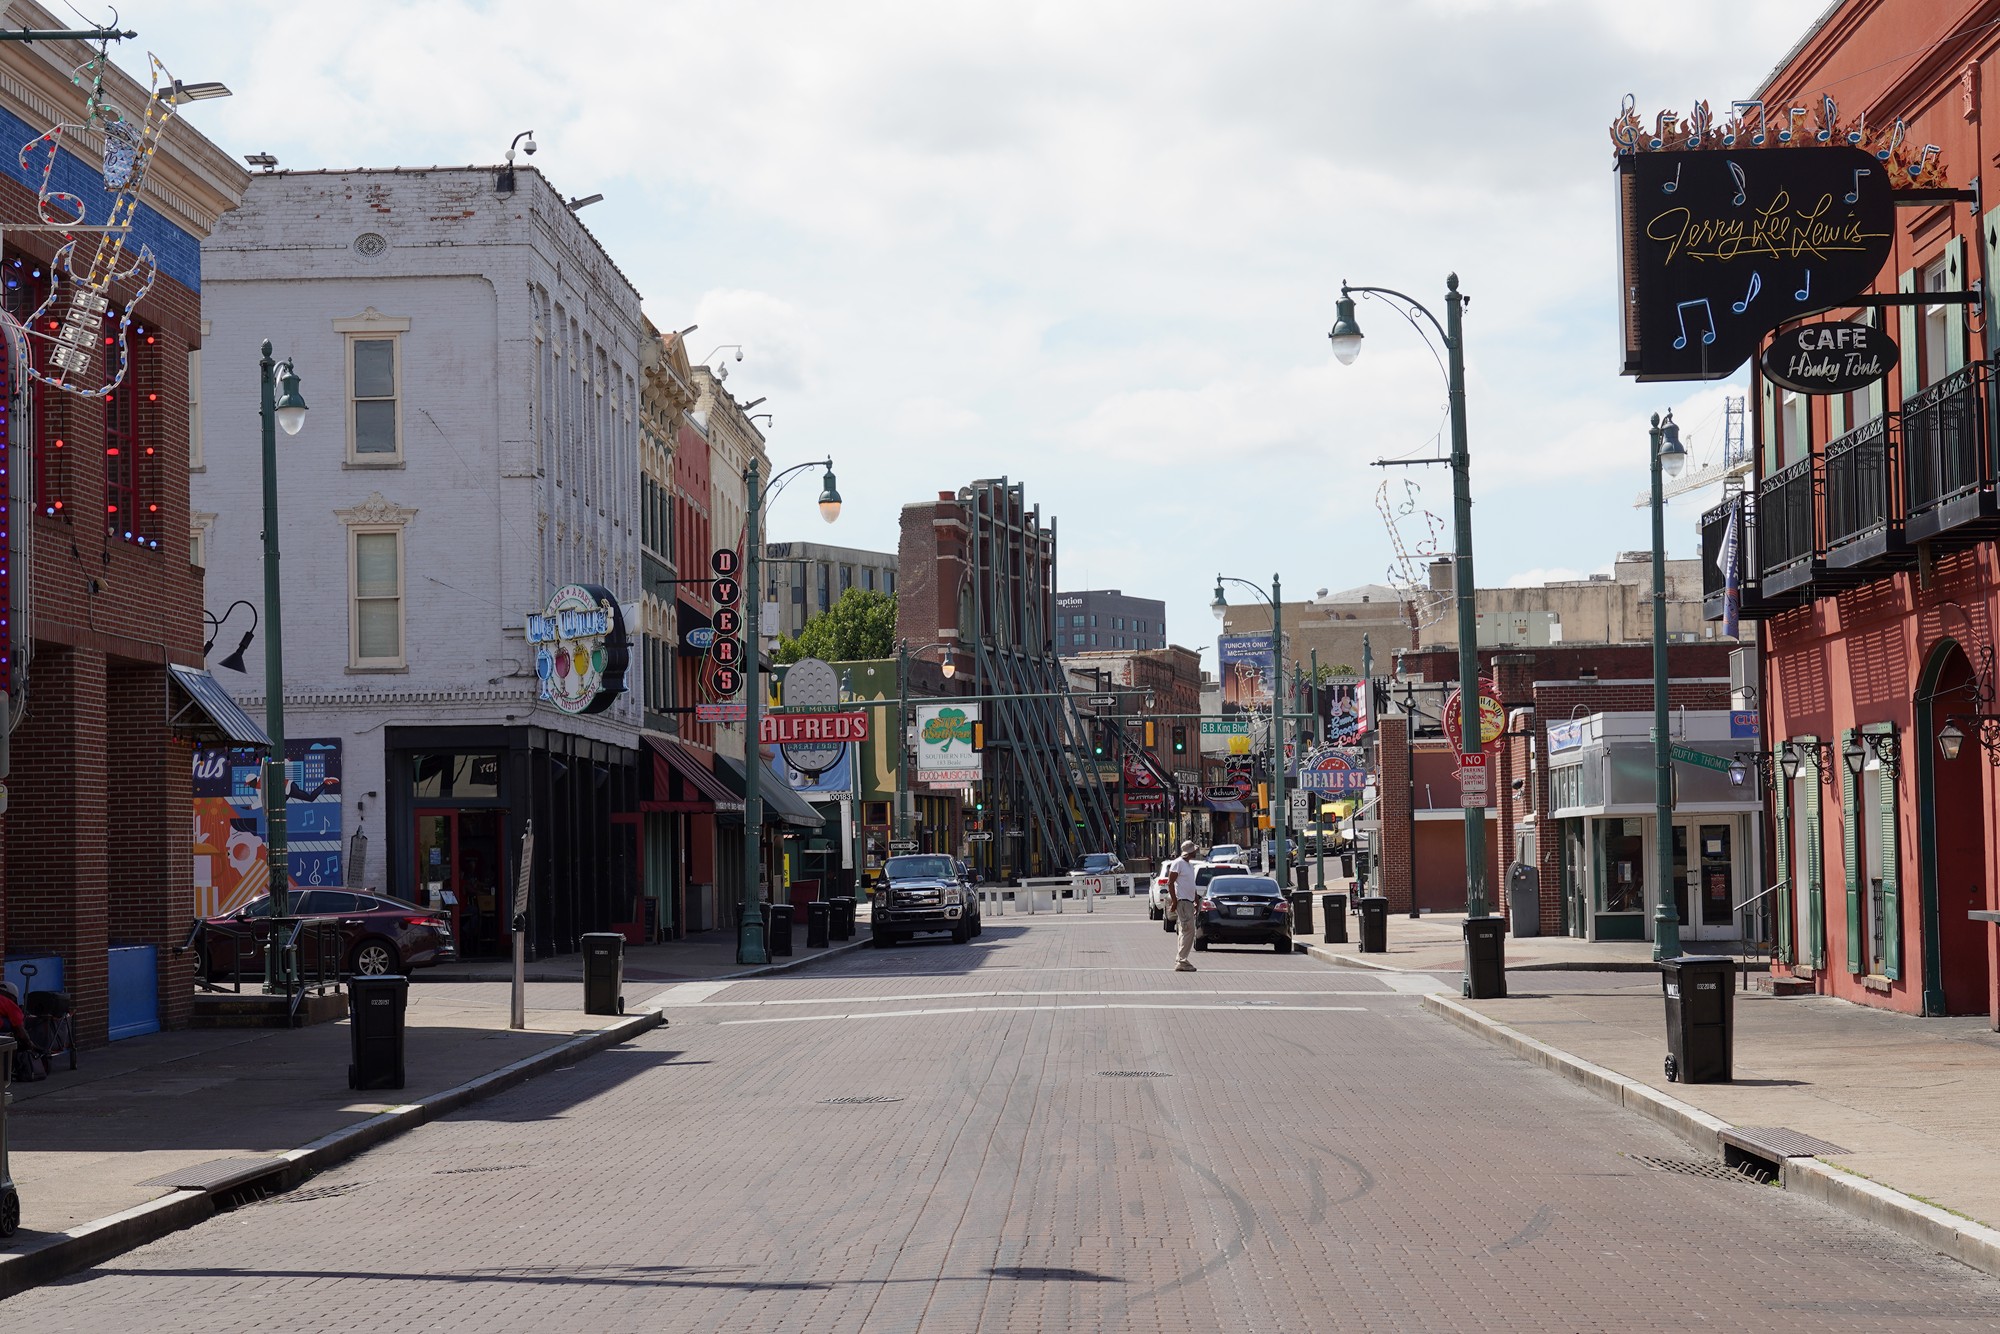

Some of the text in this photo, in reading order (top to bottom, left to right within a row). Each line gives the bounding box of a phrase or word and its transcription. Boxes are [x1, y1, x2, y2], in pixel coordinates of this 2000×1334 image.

[1647, 191, 1876, 265] Jerry Lee Lewis
[1798, 328, 1867, 350] CAFE
[1787, 352, 1882, 382] Honky Tonk
[760, 714, 867, 742] ALFRED'S
[1465, 755, 1481, 765] NO
[1672, 748, 1698, 761] RUFUS
[1303, 772, 1345, 788] BEALE
[1293, 799, 1307, 807] 20
